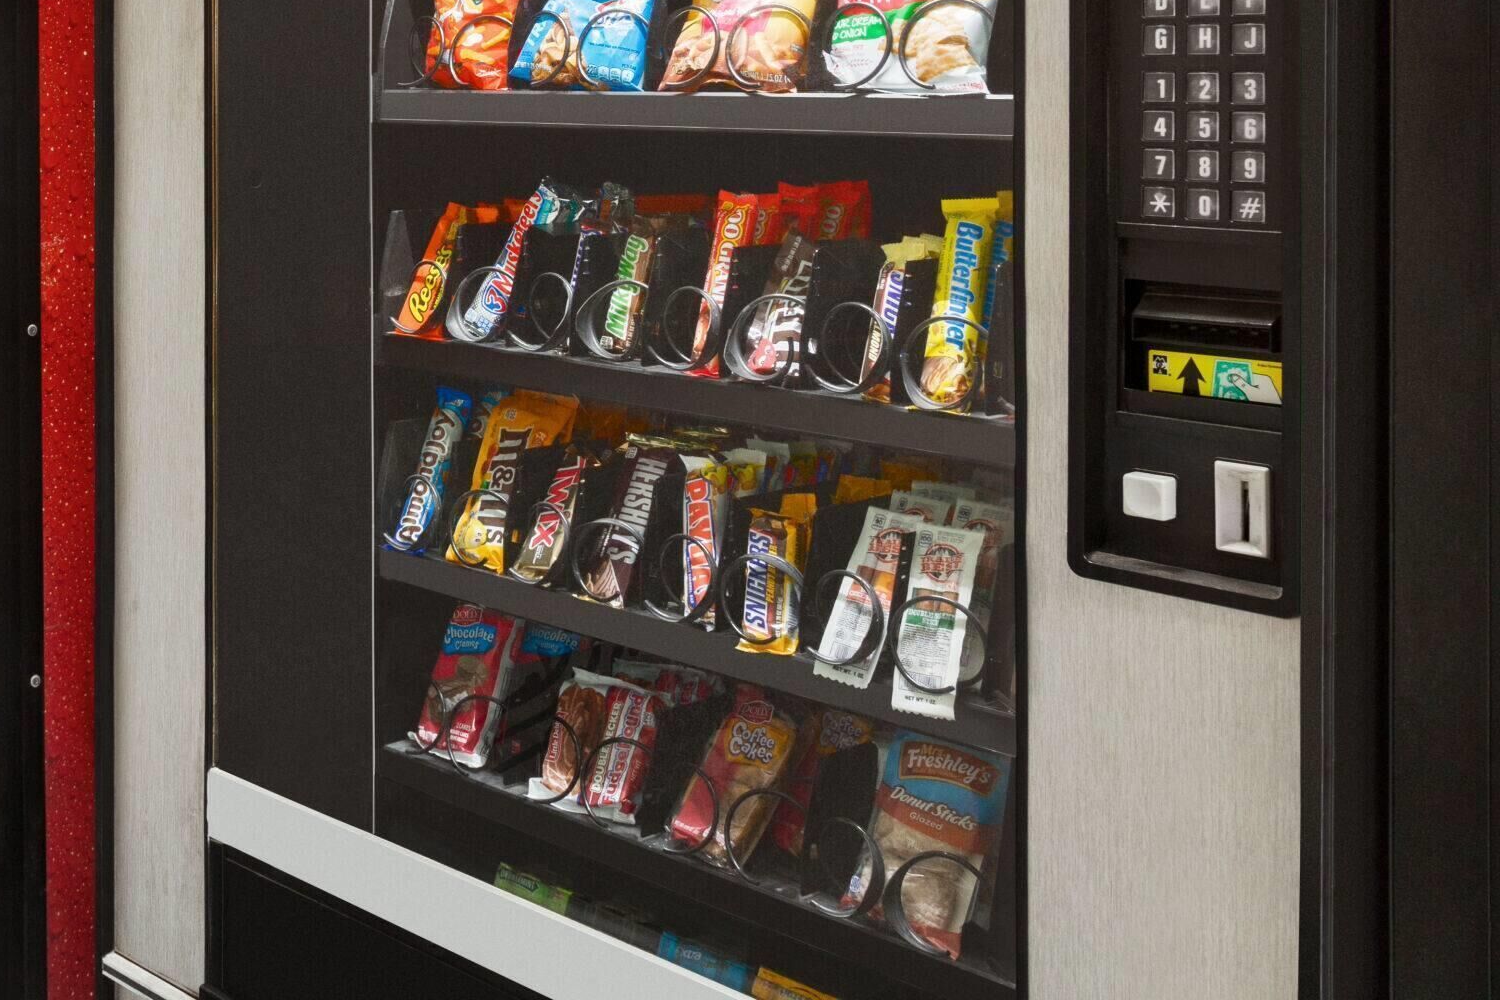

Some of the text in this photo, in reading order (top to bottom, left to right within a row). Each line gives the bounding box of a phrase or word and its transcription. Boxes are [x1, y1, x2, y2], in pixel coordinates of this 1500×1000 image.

[1155, 27, 1256, 49] G H J
[1156, 79, 1256, 100] 1 2 3
[1154, 117, 1256, 139] 4 5 6
[1154, 155, 1256, 179] 7 8 9
[1199, 196, 1210, 216] 0
[867, 320, 883, 362] LMOND
[444, 626, 495, 645] Chocolate
[604, 702, 622, 745] ECKER
[732, 721, 775, 748] Coffee
[729, 736, 773, 763] Cakes
[907, 748, 991, 785] Freshley's
[889, 785, 977, 831] Donut Sticks
[909, 811, 943, 831] Glazed
